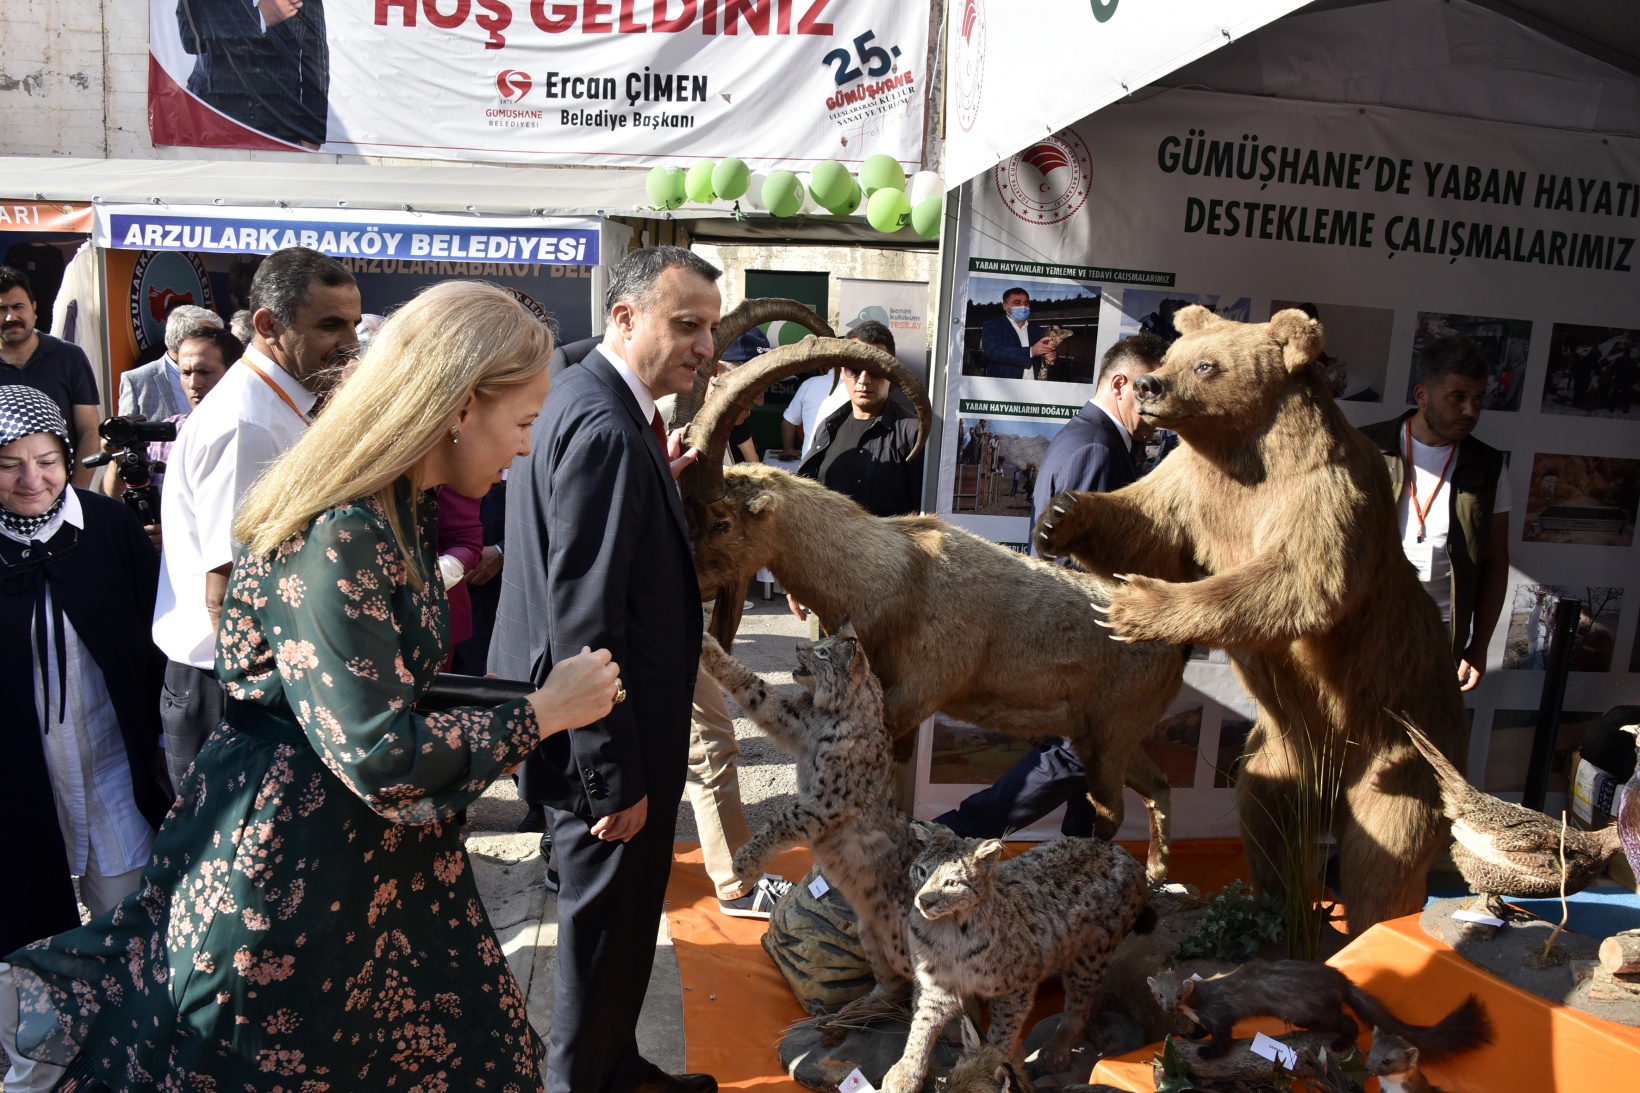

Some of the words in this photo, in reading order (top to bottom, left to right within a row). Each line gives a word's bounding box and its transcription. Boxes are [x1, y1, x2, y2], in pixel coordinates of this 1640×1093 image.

[374, 0, 512, 49] HOŞ
[546, 71, 616, 100] Ercan
[625, 66, 708, 107] ÇİMEN
[826, 70, 914, 110] GÜMÜŞHANE
[486, 109, 543, 119] GÜMÜŞHANE
[560, 109, 627, 132] Belediye
[632, 111, 695, 131] Başkanı
[829, 101, 878, 120] ULUSLARARASI
[837, 113, 863, 126] SANAT
[864, 108, 877, 118] VE
[1157, 128, 1413, 195] GÜMÜŞHANE'DE
[1423, 161, 1527, 206] YABAN
[123, 224, 403, 255] ARZULARKABAKÖY
[1184, 197, 1375, 248] DESTEKLEME
[1384, 215, 1636, 272] ÇALIŞMALARIMIZ
[975, 260, 999, 271] YABAN
[1000, 262, 1044, 274] HAYVANLARI
[1046, 266, 1076, 277] YEMLEME
[1077, 269, 1087, 278] VE
[1088, 269, 1113, 280] TEDAVİ
[1114, 272, 1170, 284] ÇALIŞMALARIMIZ
[965, 402, 988, 411] YABAN
[989, 403, 1040, 415] HAYVANLARINI
[1041, 405, 1070, 416] DOĞAYA
